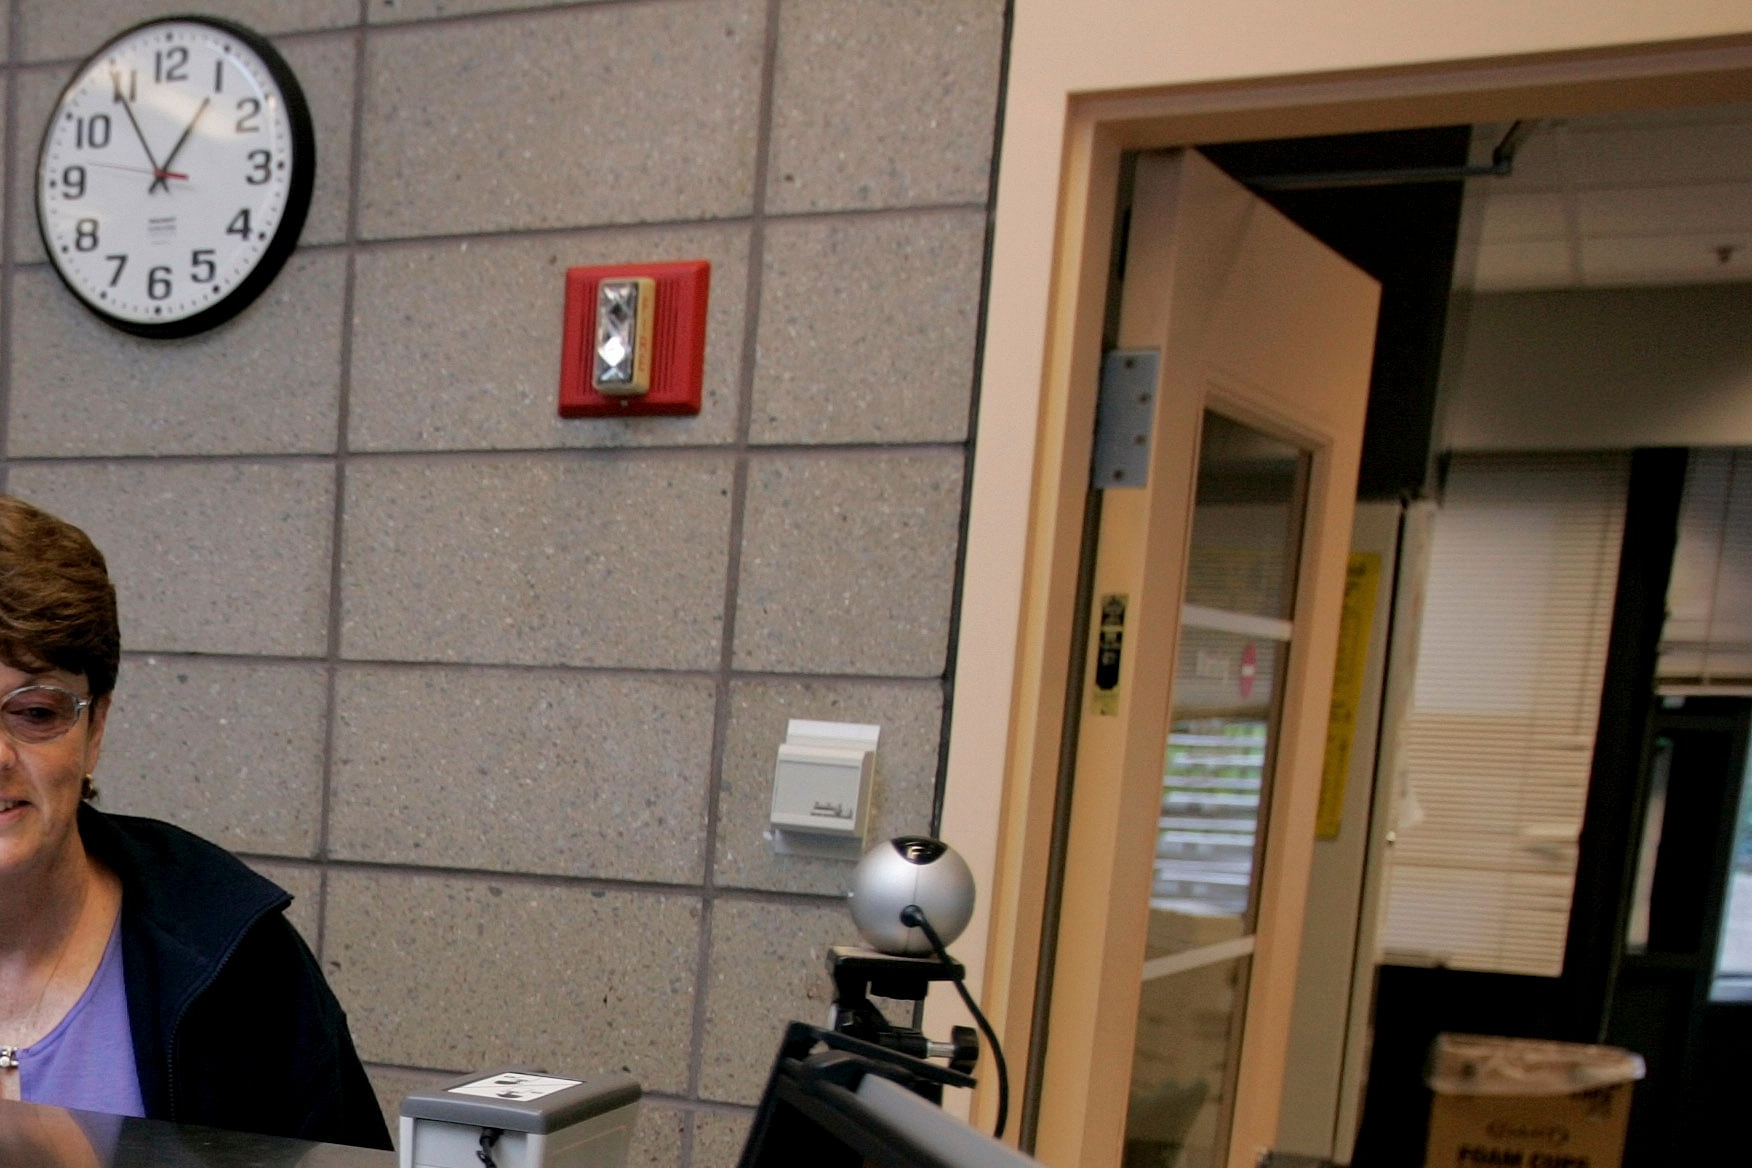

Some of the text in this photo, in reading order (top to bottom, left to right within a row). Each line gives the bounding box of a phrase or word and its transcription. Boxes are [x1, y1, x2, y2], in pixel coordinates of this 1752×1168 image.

[154, 46, 189, 83] 12
[214, 59, 224, 93] 1
[76, 114, 111, 150] 10
[235, 97, 262, 133] 2
[62, 165, 87, 200] 9
[245, 150, 273, 185] 3
[74, 218, 99, 252] 8
[226, 208, 253, 241] 4
[105, 255, 128, 287] 7
[148, 266, 172, 300] 6
[190, 250, 217, 283] 5
